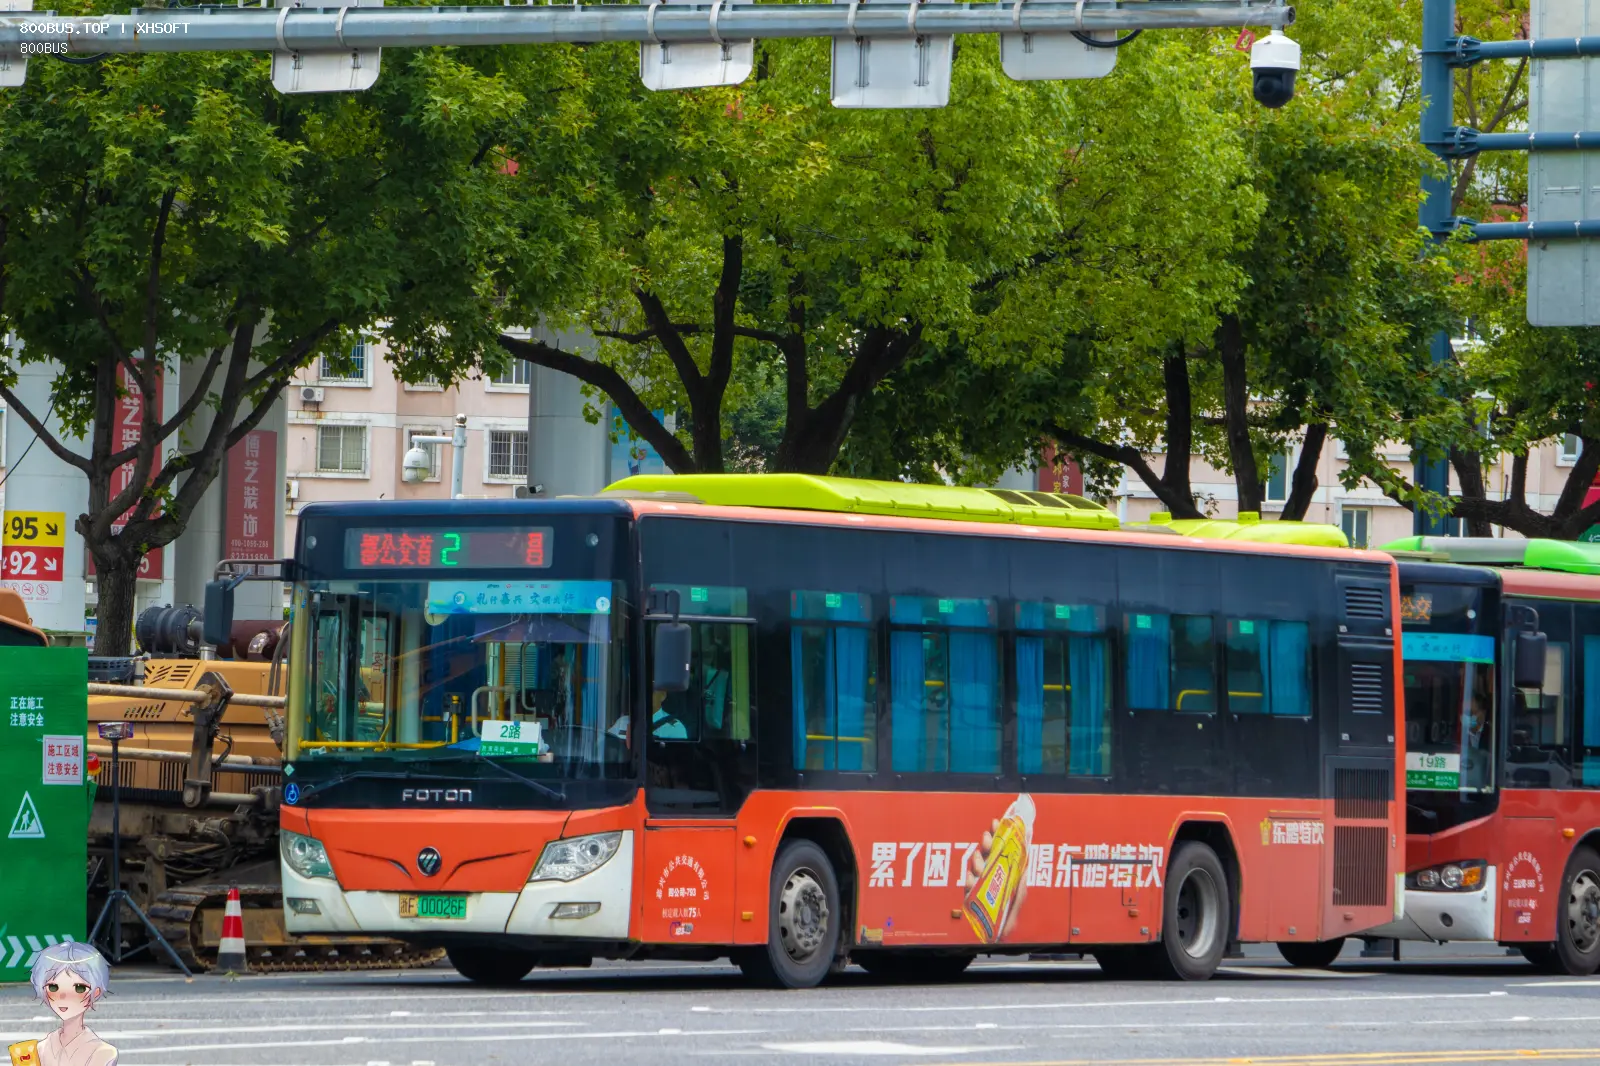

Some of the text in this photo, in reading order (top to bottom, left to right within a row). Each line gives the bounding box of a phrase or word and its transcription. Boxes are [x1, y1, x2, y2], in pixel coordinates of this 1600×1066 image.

[11, 516, 39, 540] 95
[441, 532, 461, 566] 2
[9, 550, 37, 575] 92
[10, 696, 44, 710] 正在施工
[10, 712, 44, 727] 注意安全
[500, 724, 521, 740] 2路
[47, 744, 79, 757] 施工区域
[47, 762, 79, 776] 注意安全
[1419, 756, 1446, 768] 19路
[402, 789, 472, 802] FOTON
[1272, 820, 1325, 845] 东鹏特饮
[868, 842, 1164, 888] 累了困了 喝东鹏特饮
[421, 897, 465, 915] 00026F
